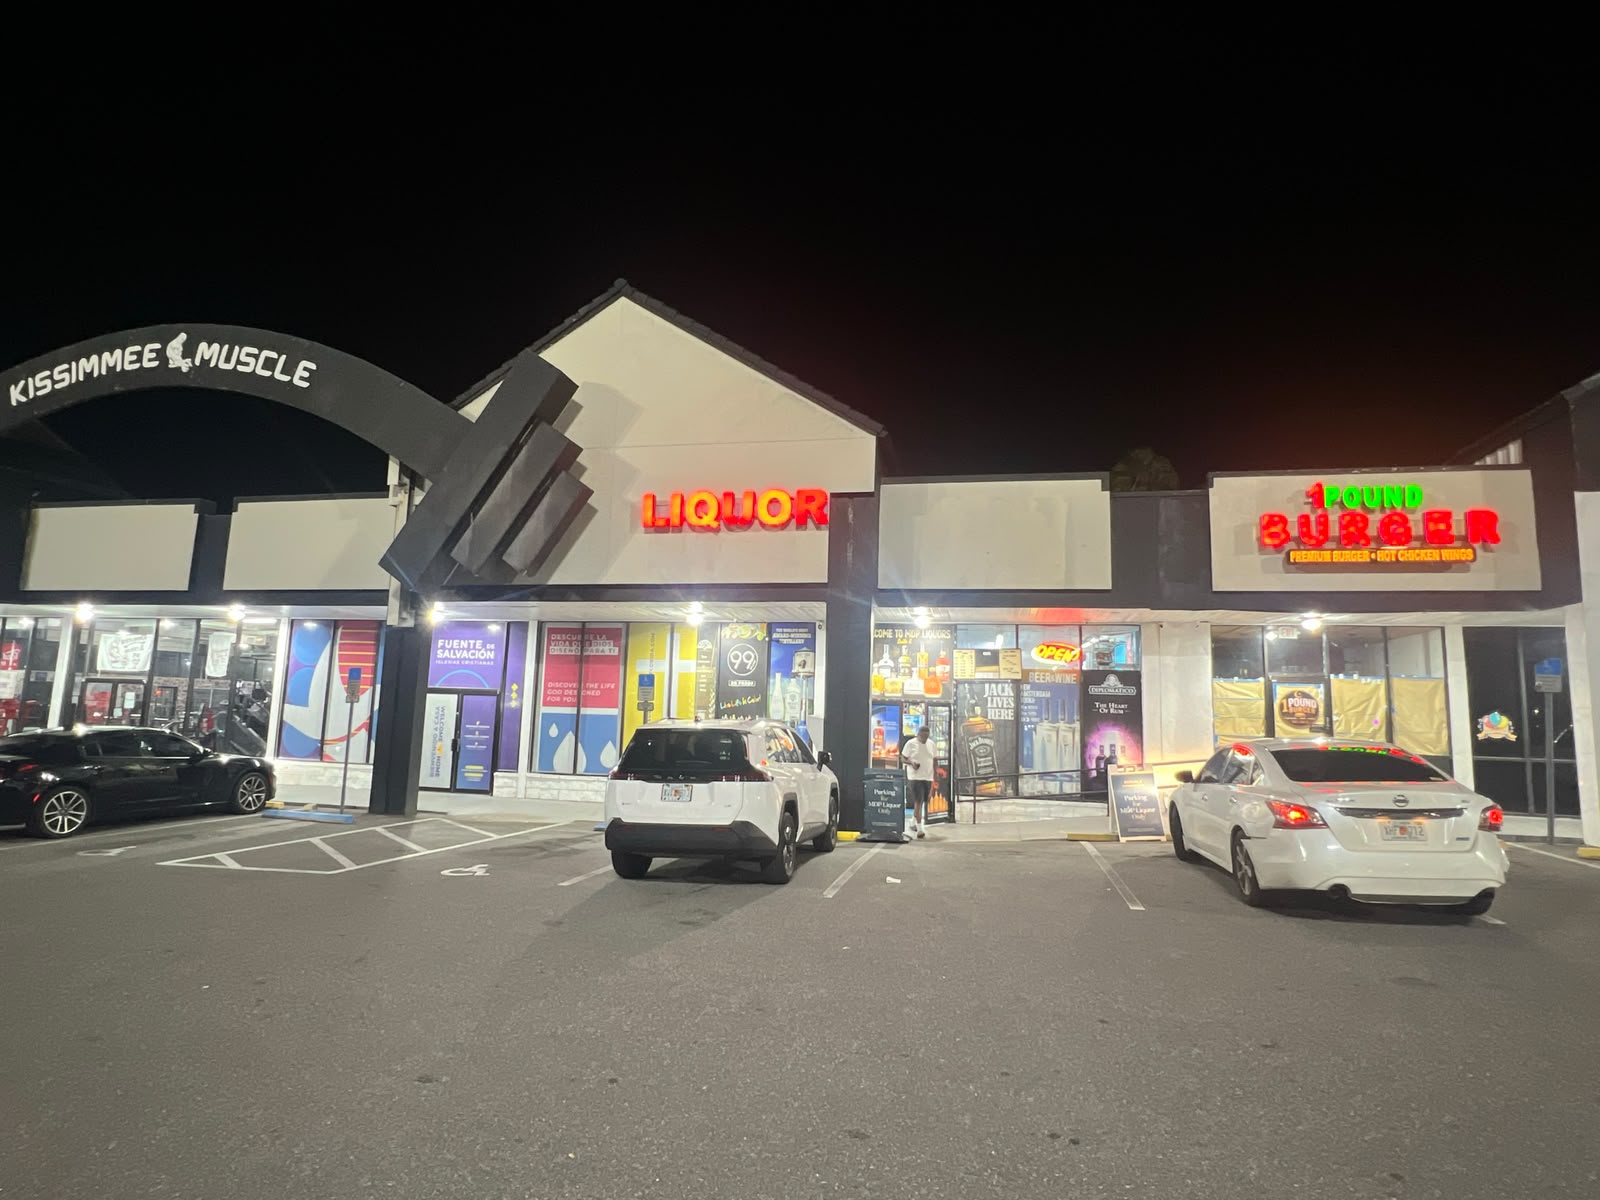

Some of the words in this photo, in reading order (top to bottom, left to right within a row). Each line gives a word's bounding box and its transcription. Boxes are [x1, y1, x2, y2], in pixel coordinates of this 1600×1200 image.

[9, 343, 162, 406] KISSIMMEE
[194, 341, 317, 388] MUSCLE
[1324, 484, 1423, 509] POUND
[641, 488, 829, 529] LIQUOR
[1261, 509, 1501, 547] BURGER
[1290, 550, 1332, 563] PREMIUM
[1333, 550, 1371, 562] BURGER
[1377, 550, 1397, 562] HOT
[1397, 549, 1440, 562] CHICKEN
[1441, 548, 1474, 561] WINGS
[921, 629, 951, 640] LIQUORS
[437, 639, 484, 650] FUENTE
[436, 648, 496, 660] SALVACIÓN
[730, 650, 755, 670] 99
[1036, 644, 1073, 663] OPEN
[983, 683, 1014, 698] JACK
[987, 697, 1014, 708] LIVES
[1287, 697, 1317, 709] POUND
[987, 708, 1014, 721] HERE
[873, 788, 896, 797] Parking
[883, 801, 902, 810] Liquor
